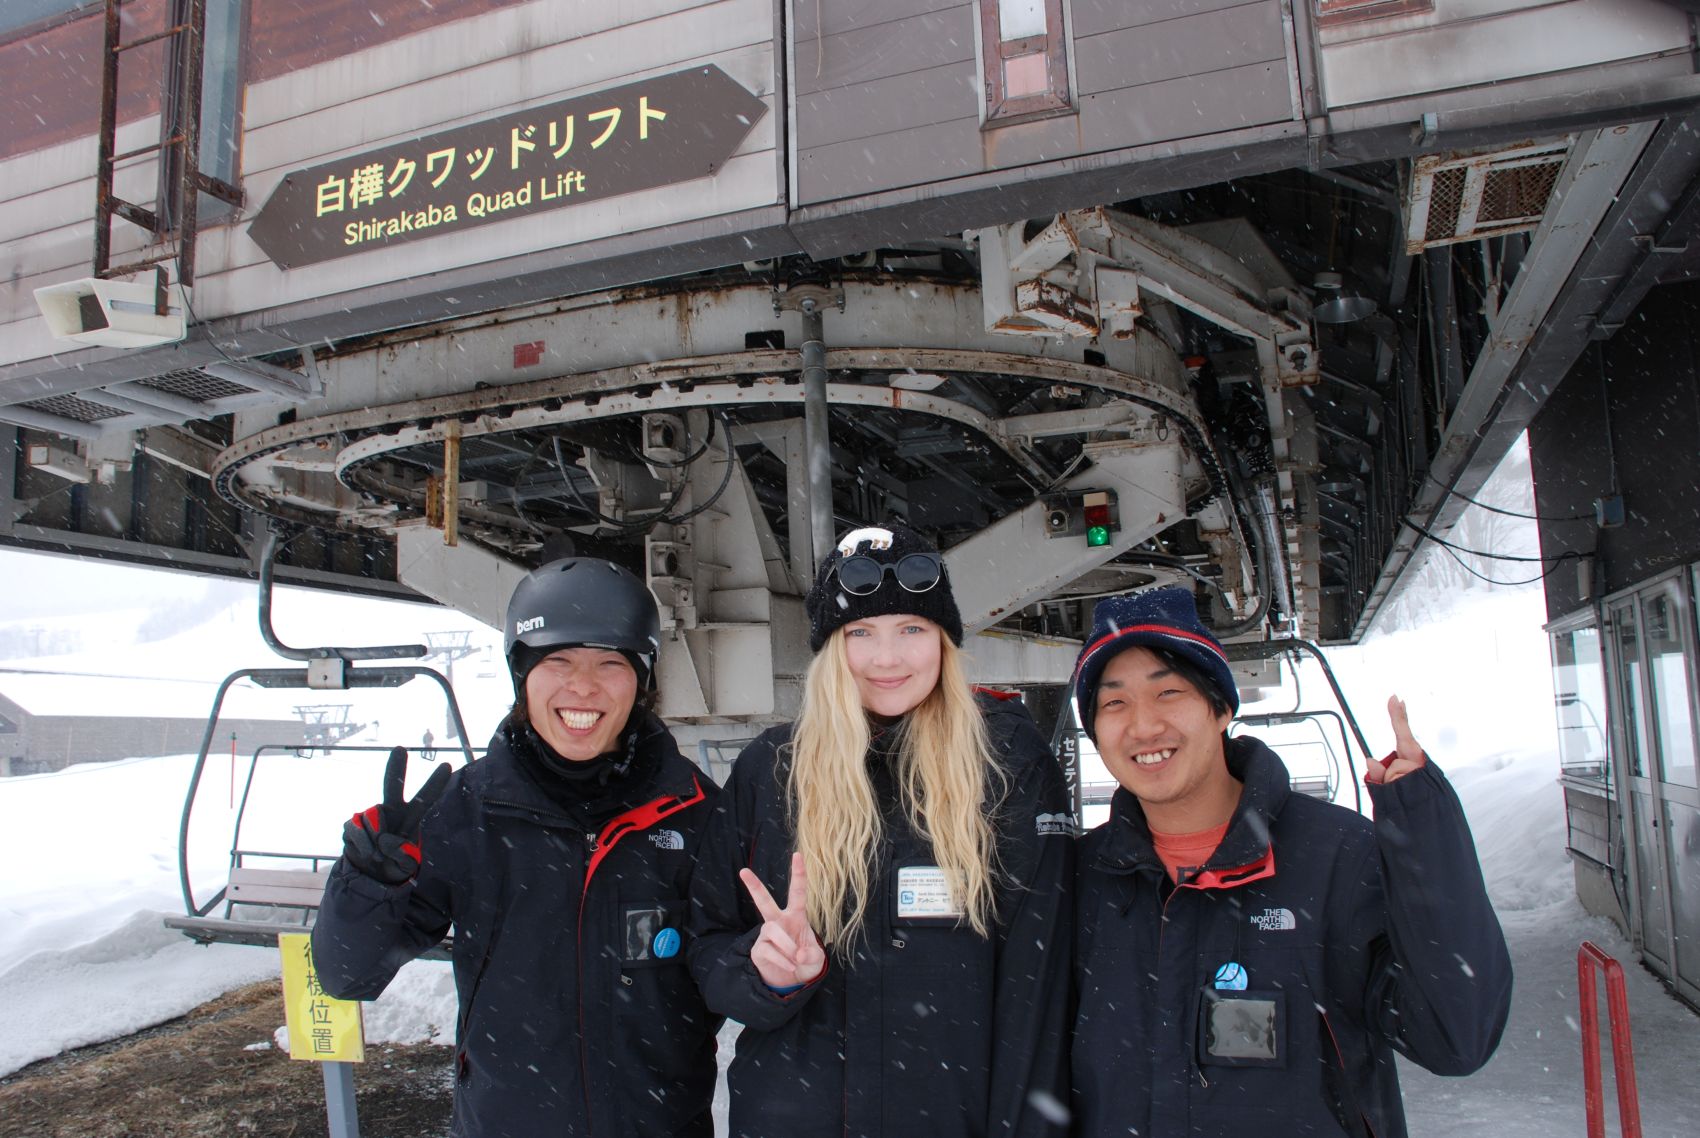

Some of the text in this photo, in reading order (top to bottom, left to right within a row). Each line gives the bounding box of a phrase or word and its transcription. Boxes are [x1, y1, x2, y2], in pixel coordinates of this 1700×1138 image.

[316, 96, 667, 217] 白樺クワッドリフト
[344, 171, 586, 246] Shirakaba Quad Lift
[516, 616, 545, 635] bern
[659, 829, 672, 837] THE
[1264, 908, 1281, 916] THE
[1250, 916, 1281, 924] NORTH
[1259, 923, 1281, 931] FACE
